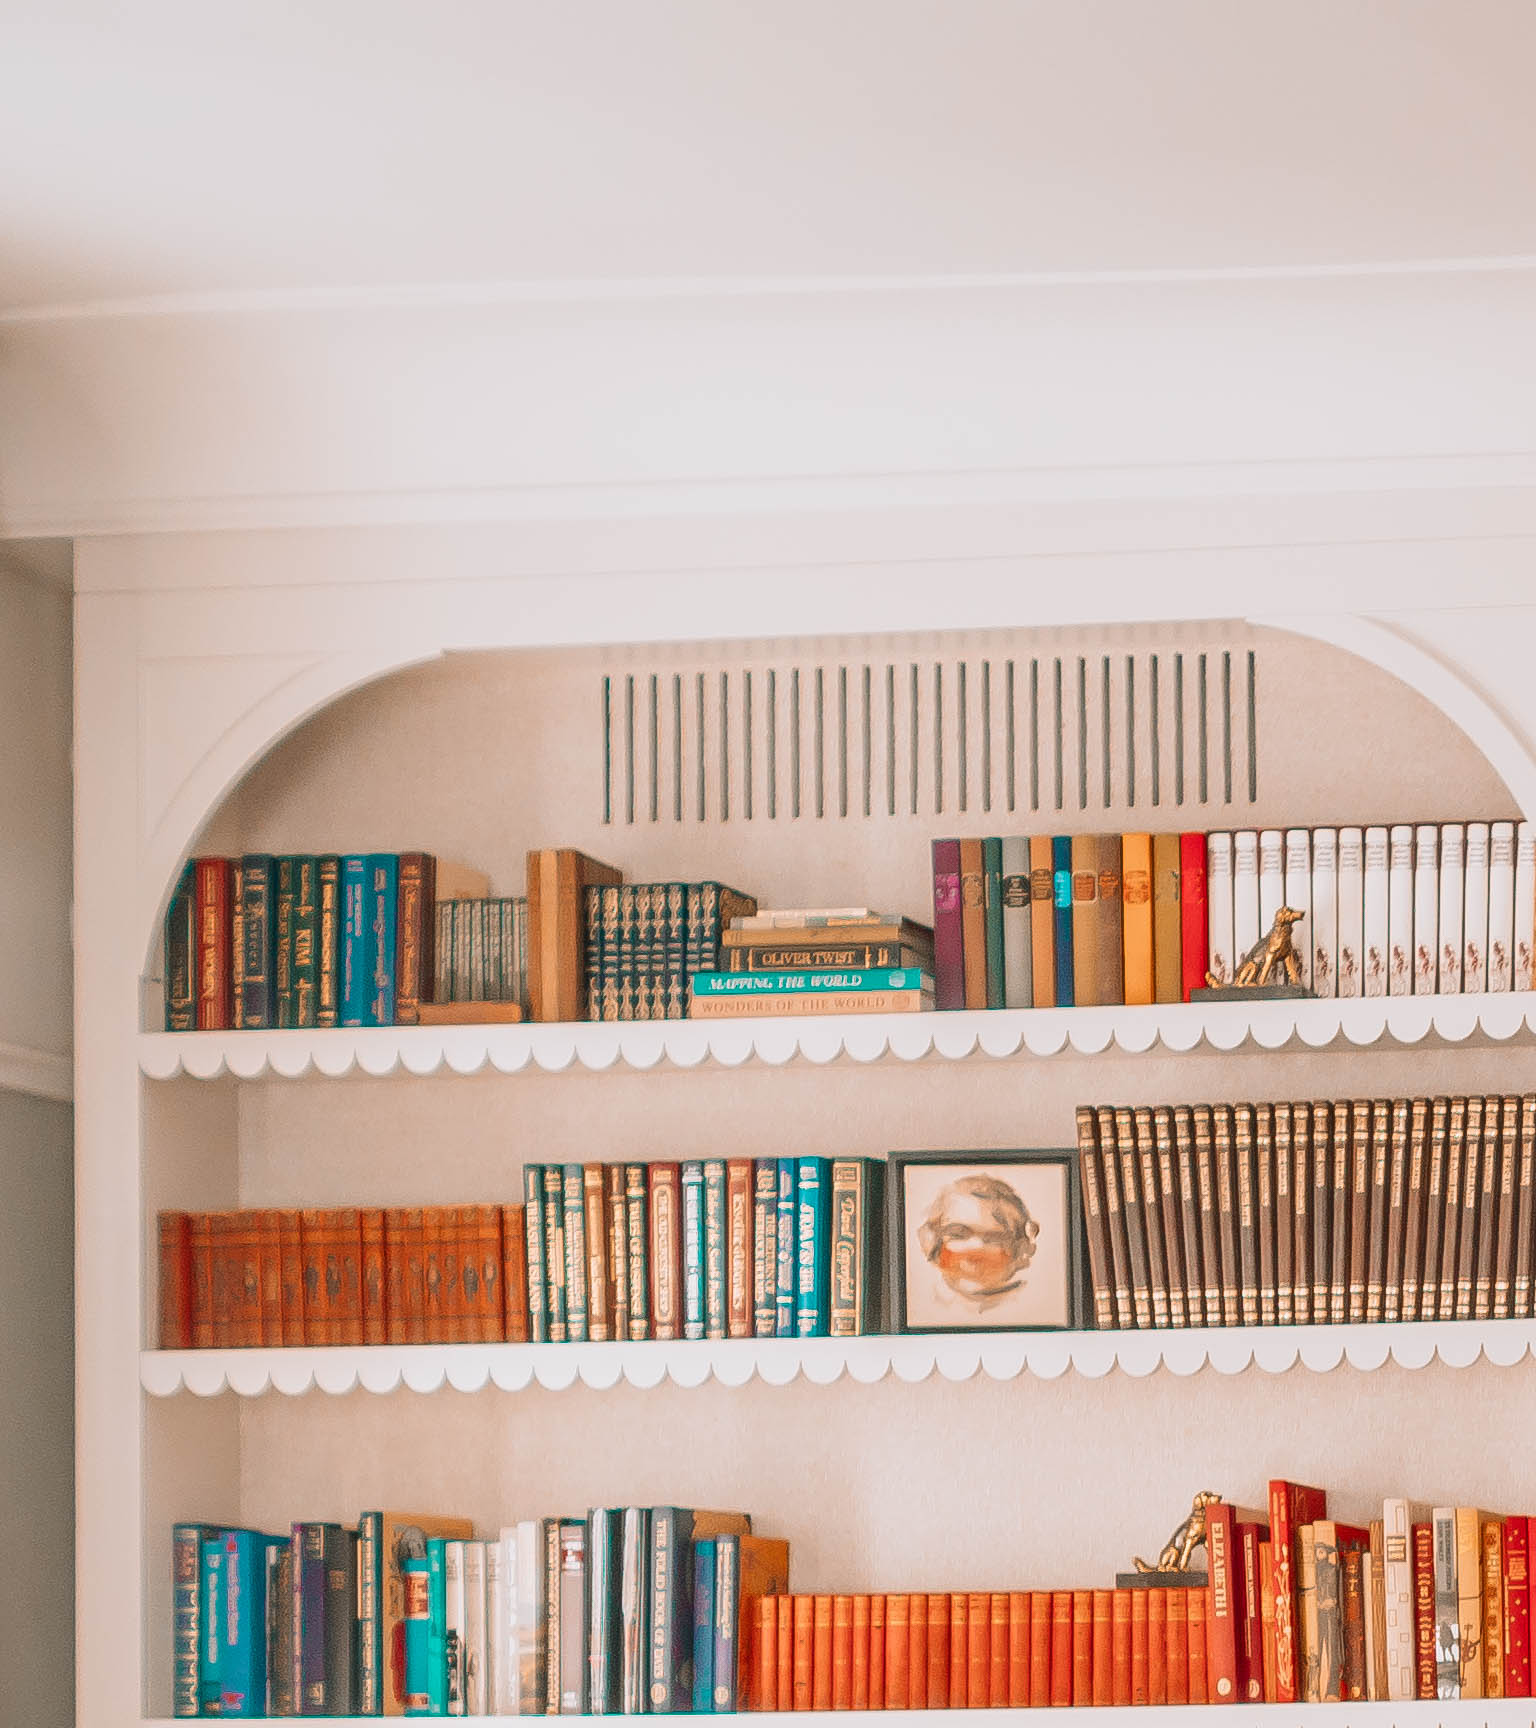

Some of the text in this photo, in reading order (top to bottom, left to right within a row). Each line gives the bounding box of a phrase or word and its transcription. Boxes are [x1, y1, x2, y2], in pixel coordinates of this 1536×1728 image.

[295, 929, 313, 966] KIM
[762, 951, 857, 966] OLIVER TWIST
[709, 974, 862, 990] MAPPING THE WORLD
[702, 997, 886, 1013] WONDERS OF THE WORLD
[1211, 1522, 1227, 1607] ELIZABETH
